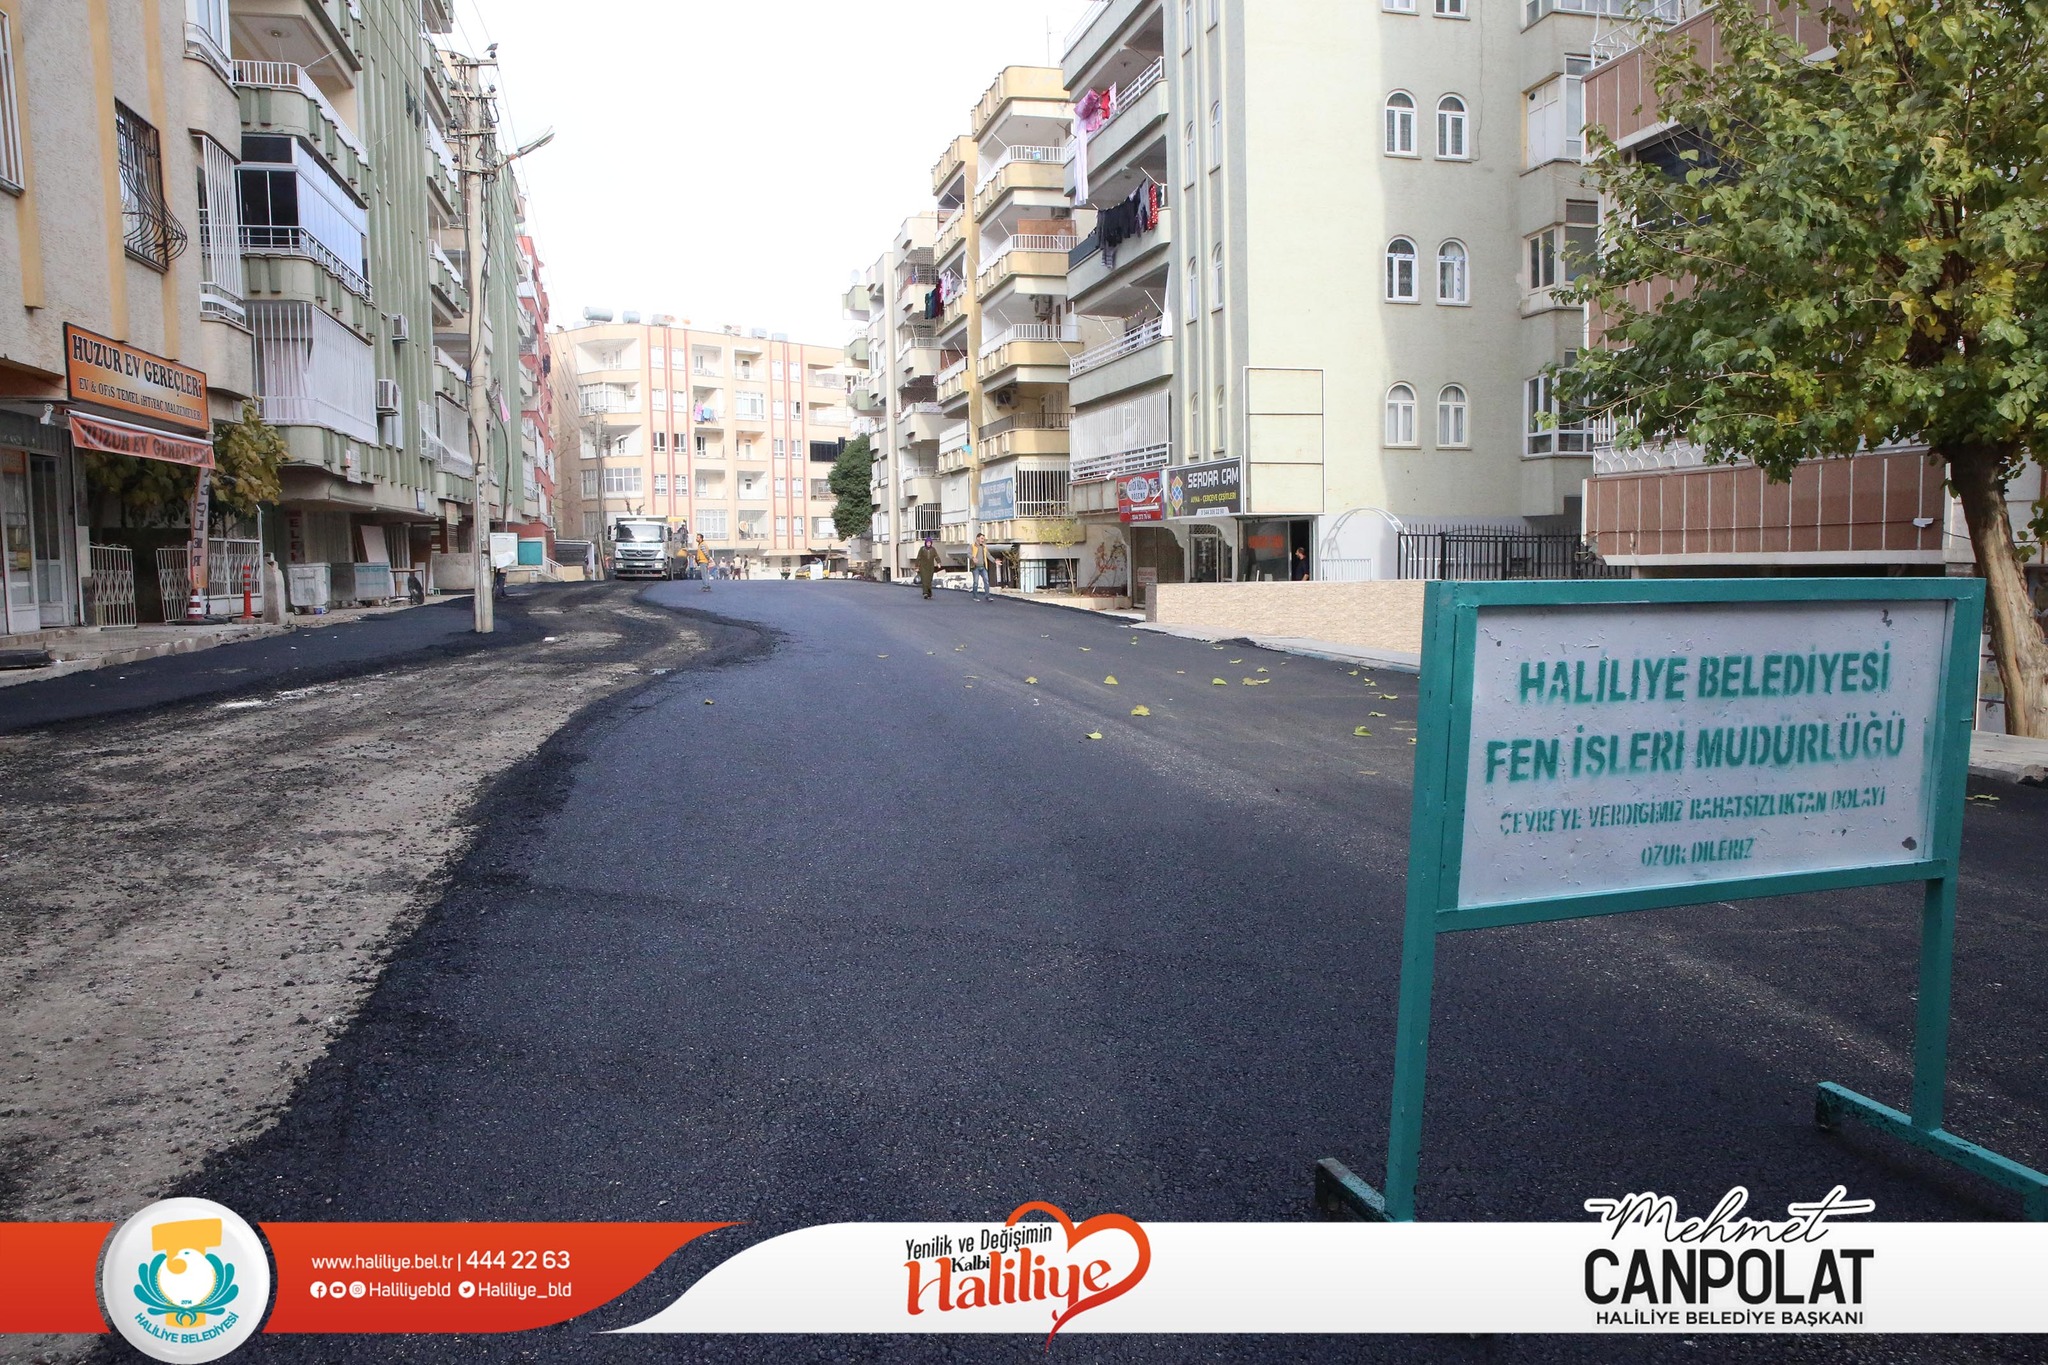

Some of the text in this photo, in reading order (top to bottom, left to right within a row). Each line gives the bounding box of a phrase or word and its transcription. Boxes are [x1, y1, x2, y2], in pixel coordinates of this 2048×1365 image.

[72, 334, 123, 374] HUZUR
[124, 353, 142, 379] EV
[79, 377, 90, 391] EV
[91, 380, 98, 394] &
[116, 387, 140, 405] TEMEL
[132, 434, 149, 454] EV
[1187, 466, 1239, 489] SERDAR CAM
[1697, 640, 1891, 699] BELEDİYESİ
[1485, 738, 1560, 784] FEN
